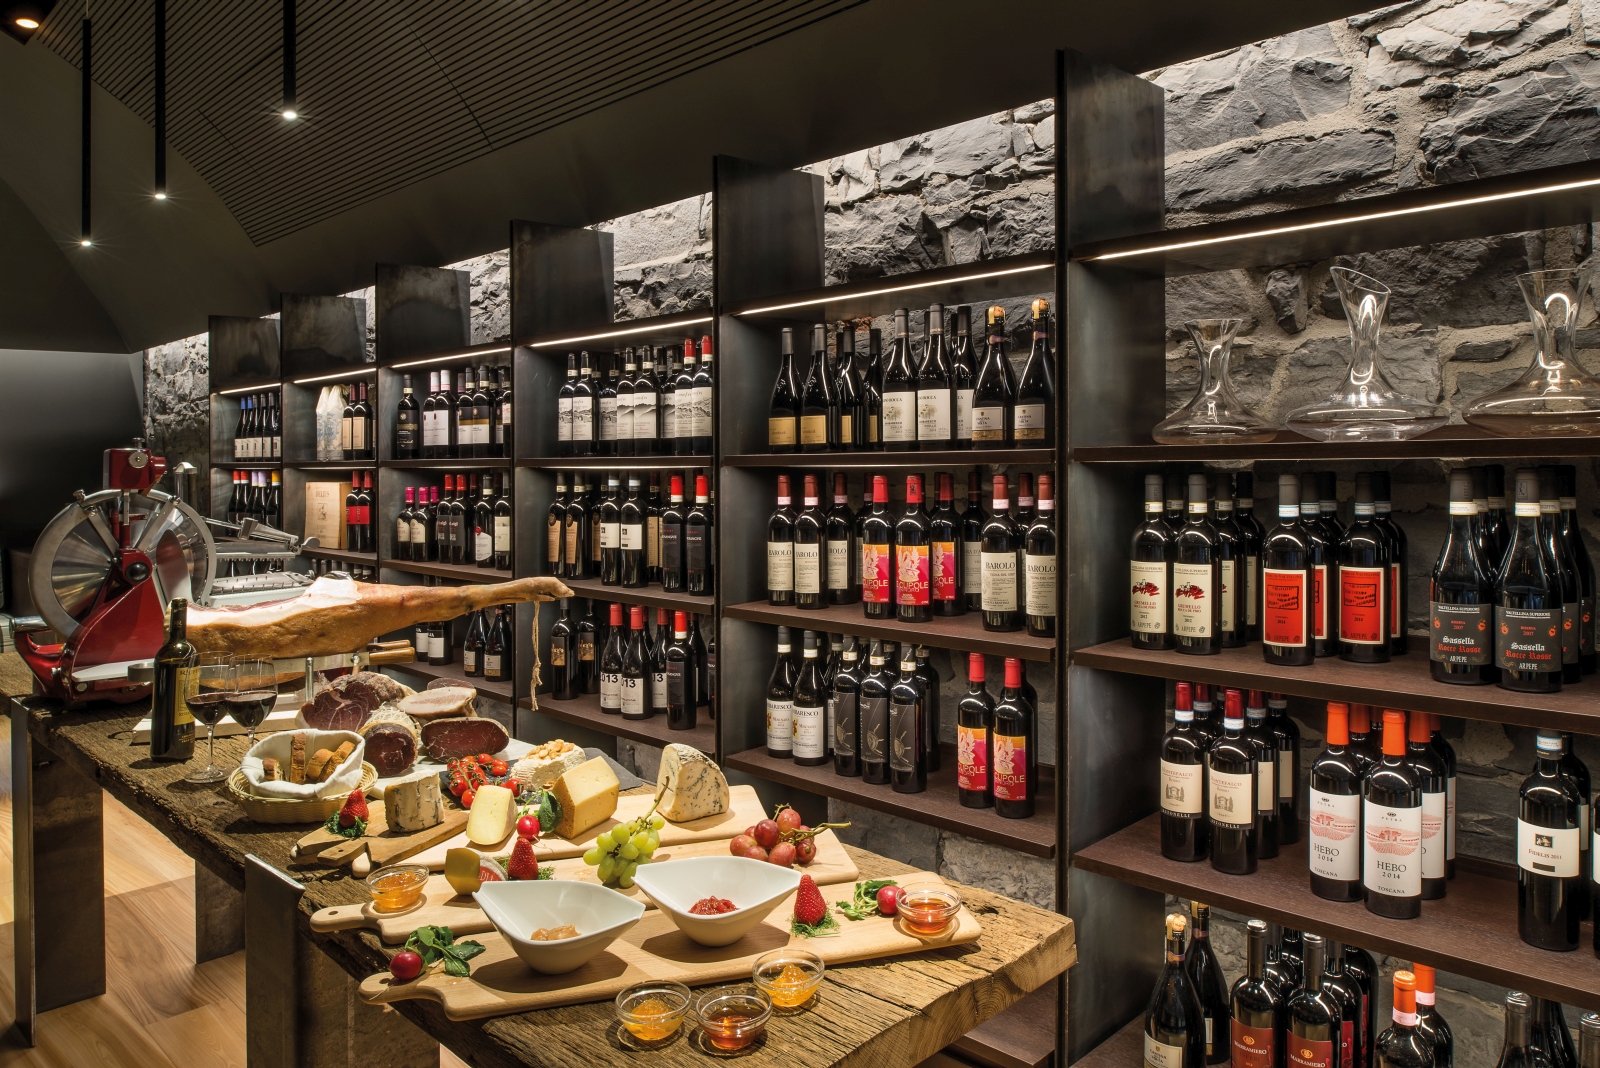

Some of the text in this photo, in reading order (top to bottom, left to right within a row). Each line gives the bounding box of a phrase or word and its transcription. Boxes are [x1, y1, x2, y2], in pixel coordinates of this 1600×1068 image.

[933, 576, 954, 584] POLE
[900, 581, 928, 590] CUPOLE
[1443, 636, 1474, 645] Sassella
[1438, 643, 1481, 653] Rocce Rosse
[1510, 642, 1545, 651] Sassella
[1505, 650, 1551, 660] Rocce Rosse
[958, 763, 985, 774] CUPOLE
[1162, 766, 1193, 777] MONTEFALCO
[994, 772, 1025, 783] CUPOLE
[1211, 776, 1242, 787] MONTEFALCO
[1314, 843, 1339, 856] HEBO
[1528, 848, 1549, 858] FIDELIS
[1318, 854, 1334, 862] 2014
[1377, 860, 1407, 872] HEBO
[1314, 867, 1338, 877] TOSCANA
[1378, 886, 1405, 894] TOSCANA
[1234, 1040, 1267, 1055] MARRAMIERO
[1290, 1054, 1325, 1068] MARRAMIERO
